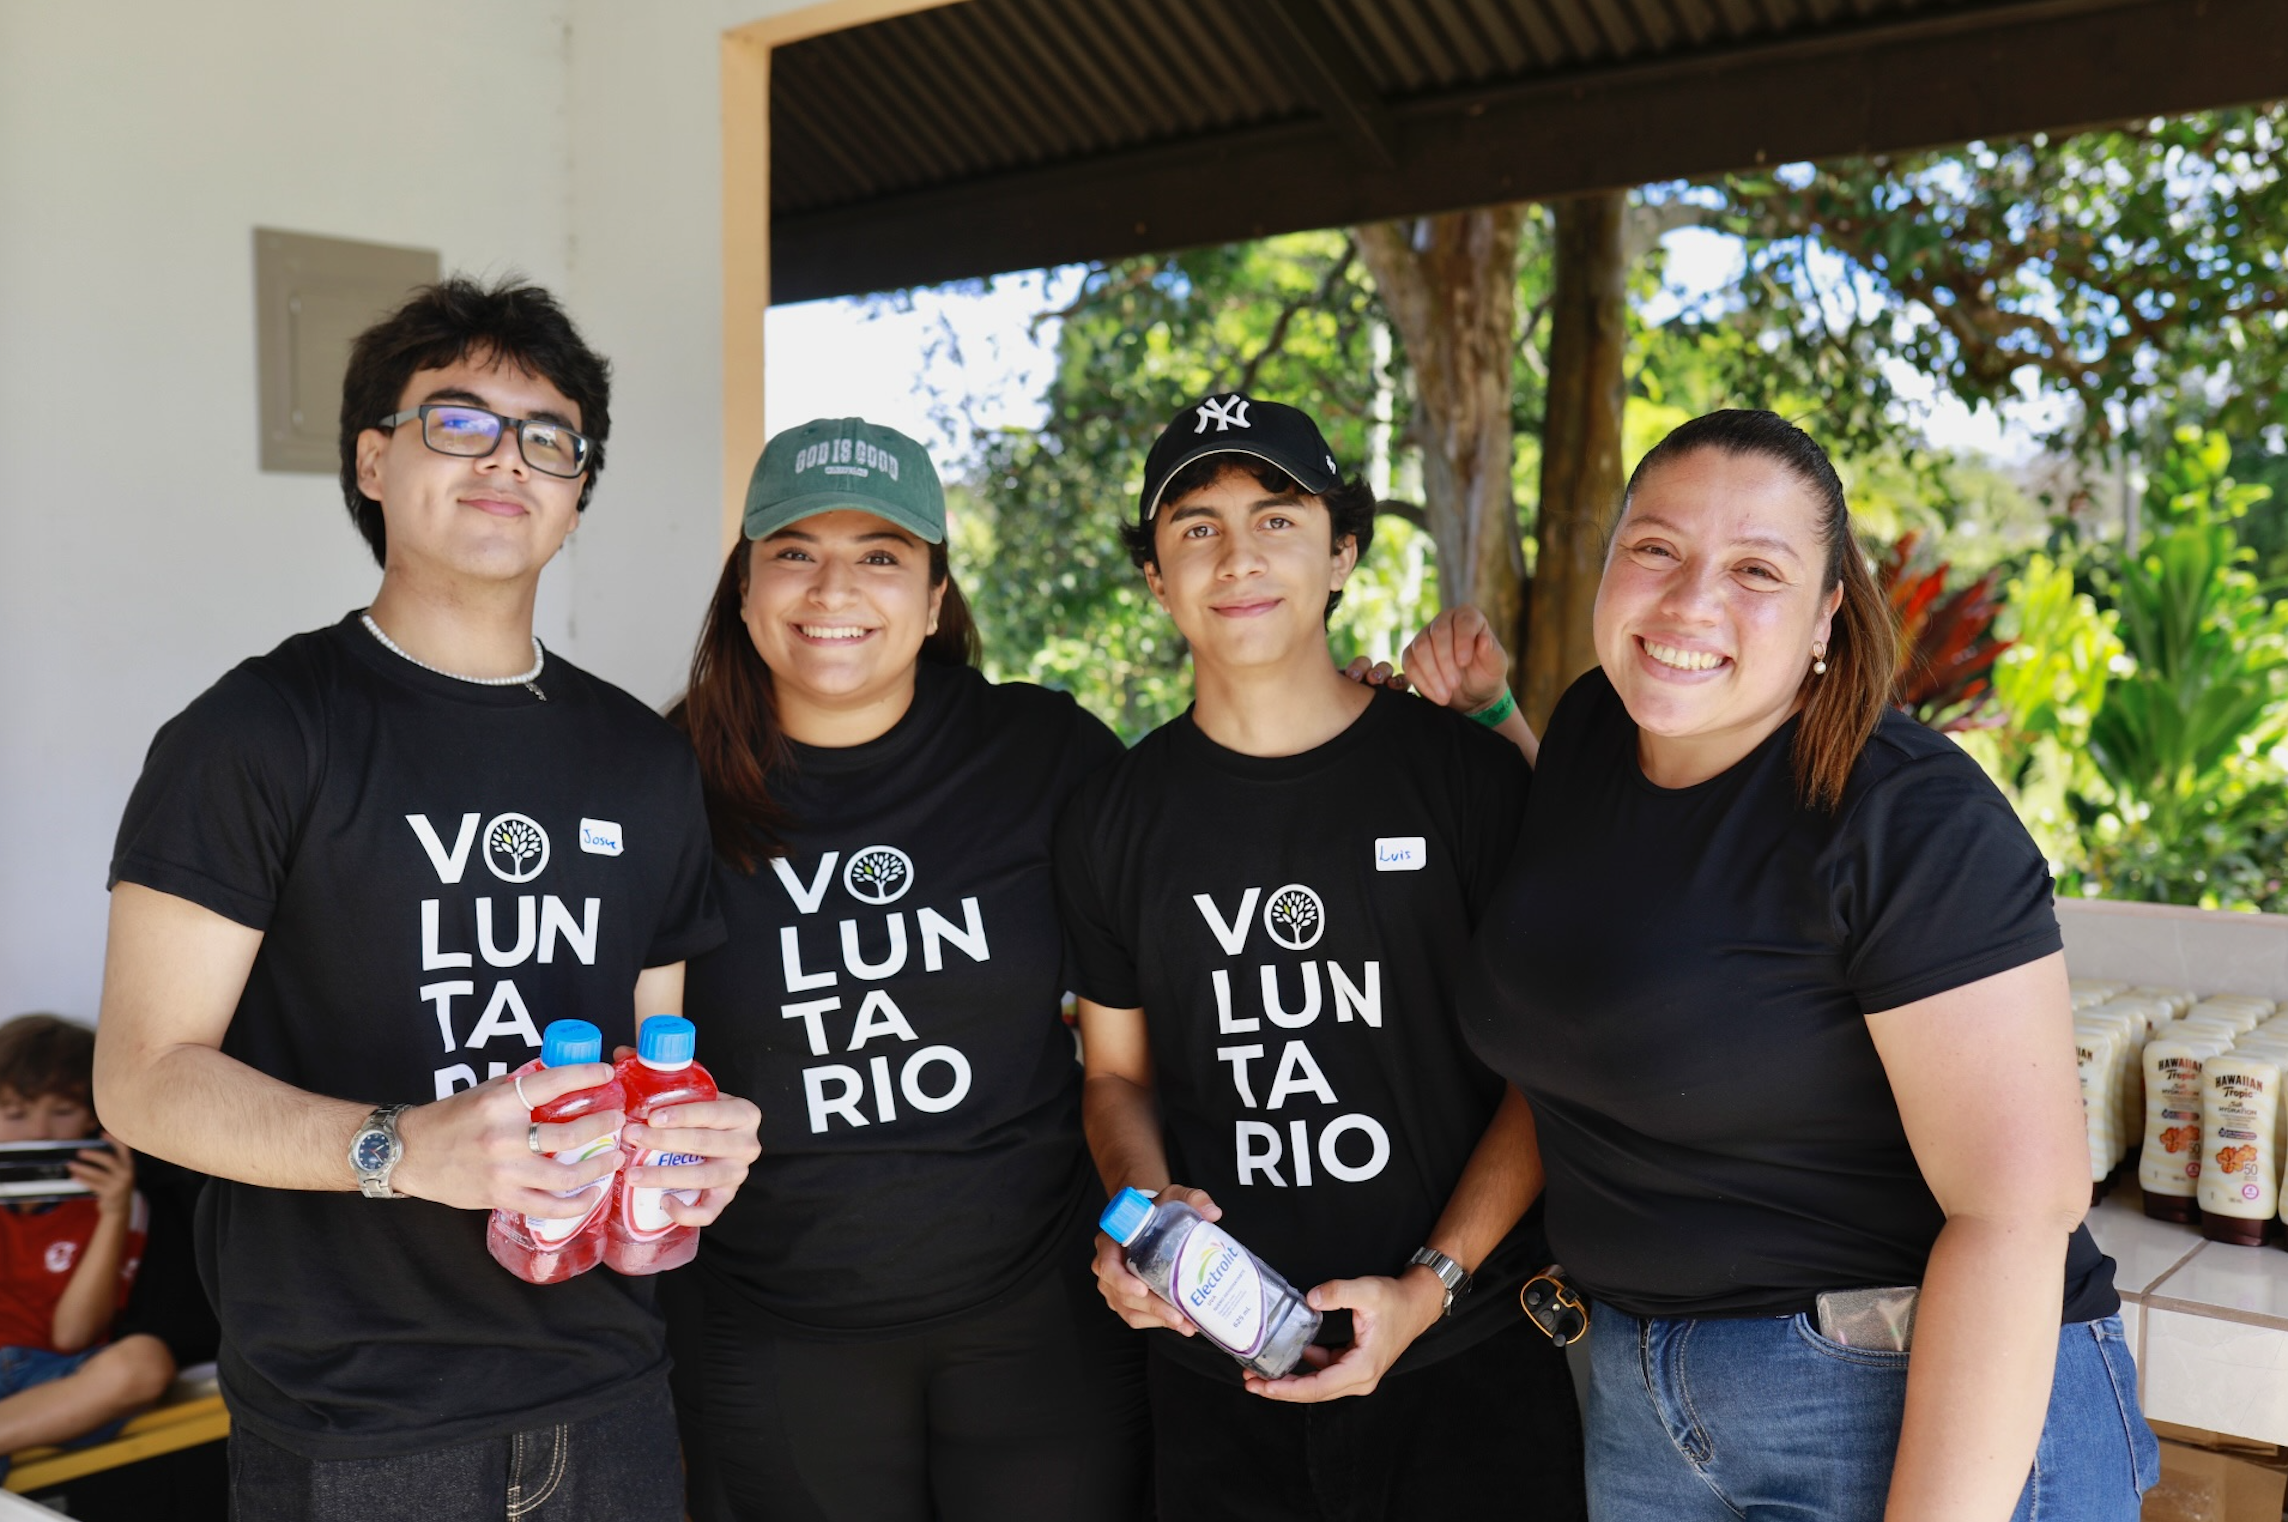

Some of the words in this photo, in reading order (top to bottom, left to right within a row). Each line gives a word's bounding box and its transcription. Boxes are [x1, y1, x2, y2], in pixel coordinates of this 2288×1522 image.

[1194, 394, 1251, 434] NY
[1379, 844, 1412, 862] Luis
[420, 894, 601, 971] LUN
[780, 896, 990, 993] LUN
[419, 980, 543, 1054] TA
[781, 989, 919, 1056] TA
[1212, 960, 1382, 1034] LUN
[802, 1045, 972, 1134] RIO
[1217, 1040, 1339, 1110] TA
[2215, 1074, 2263, 1092] HAWAIIAN
[2223, 1086, 2253, 1099] Tropic
[1235, 1113, 1391, 1188] RIO
[2244, 1163, 2258, 1176] 50
[1190, 1247, 1238, 1307] Electrolit
